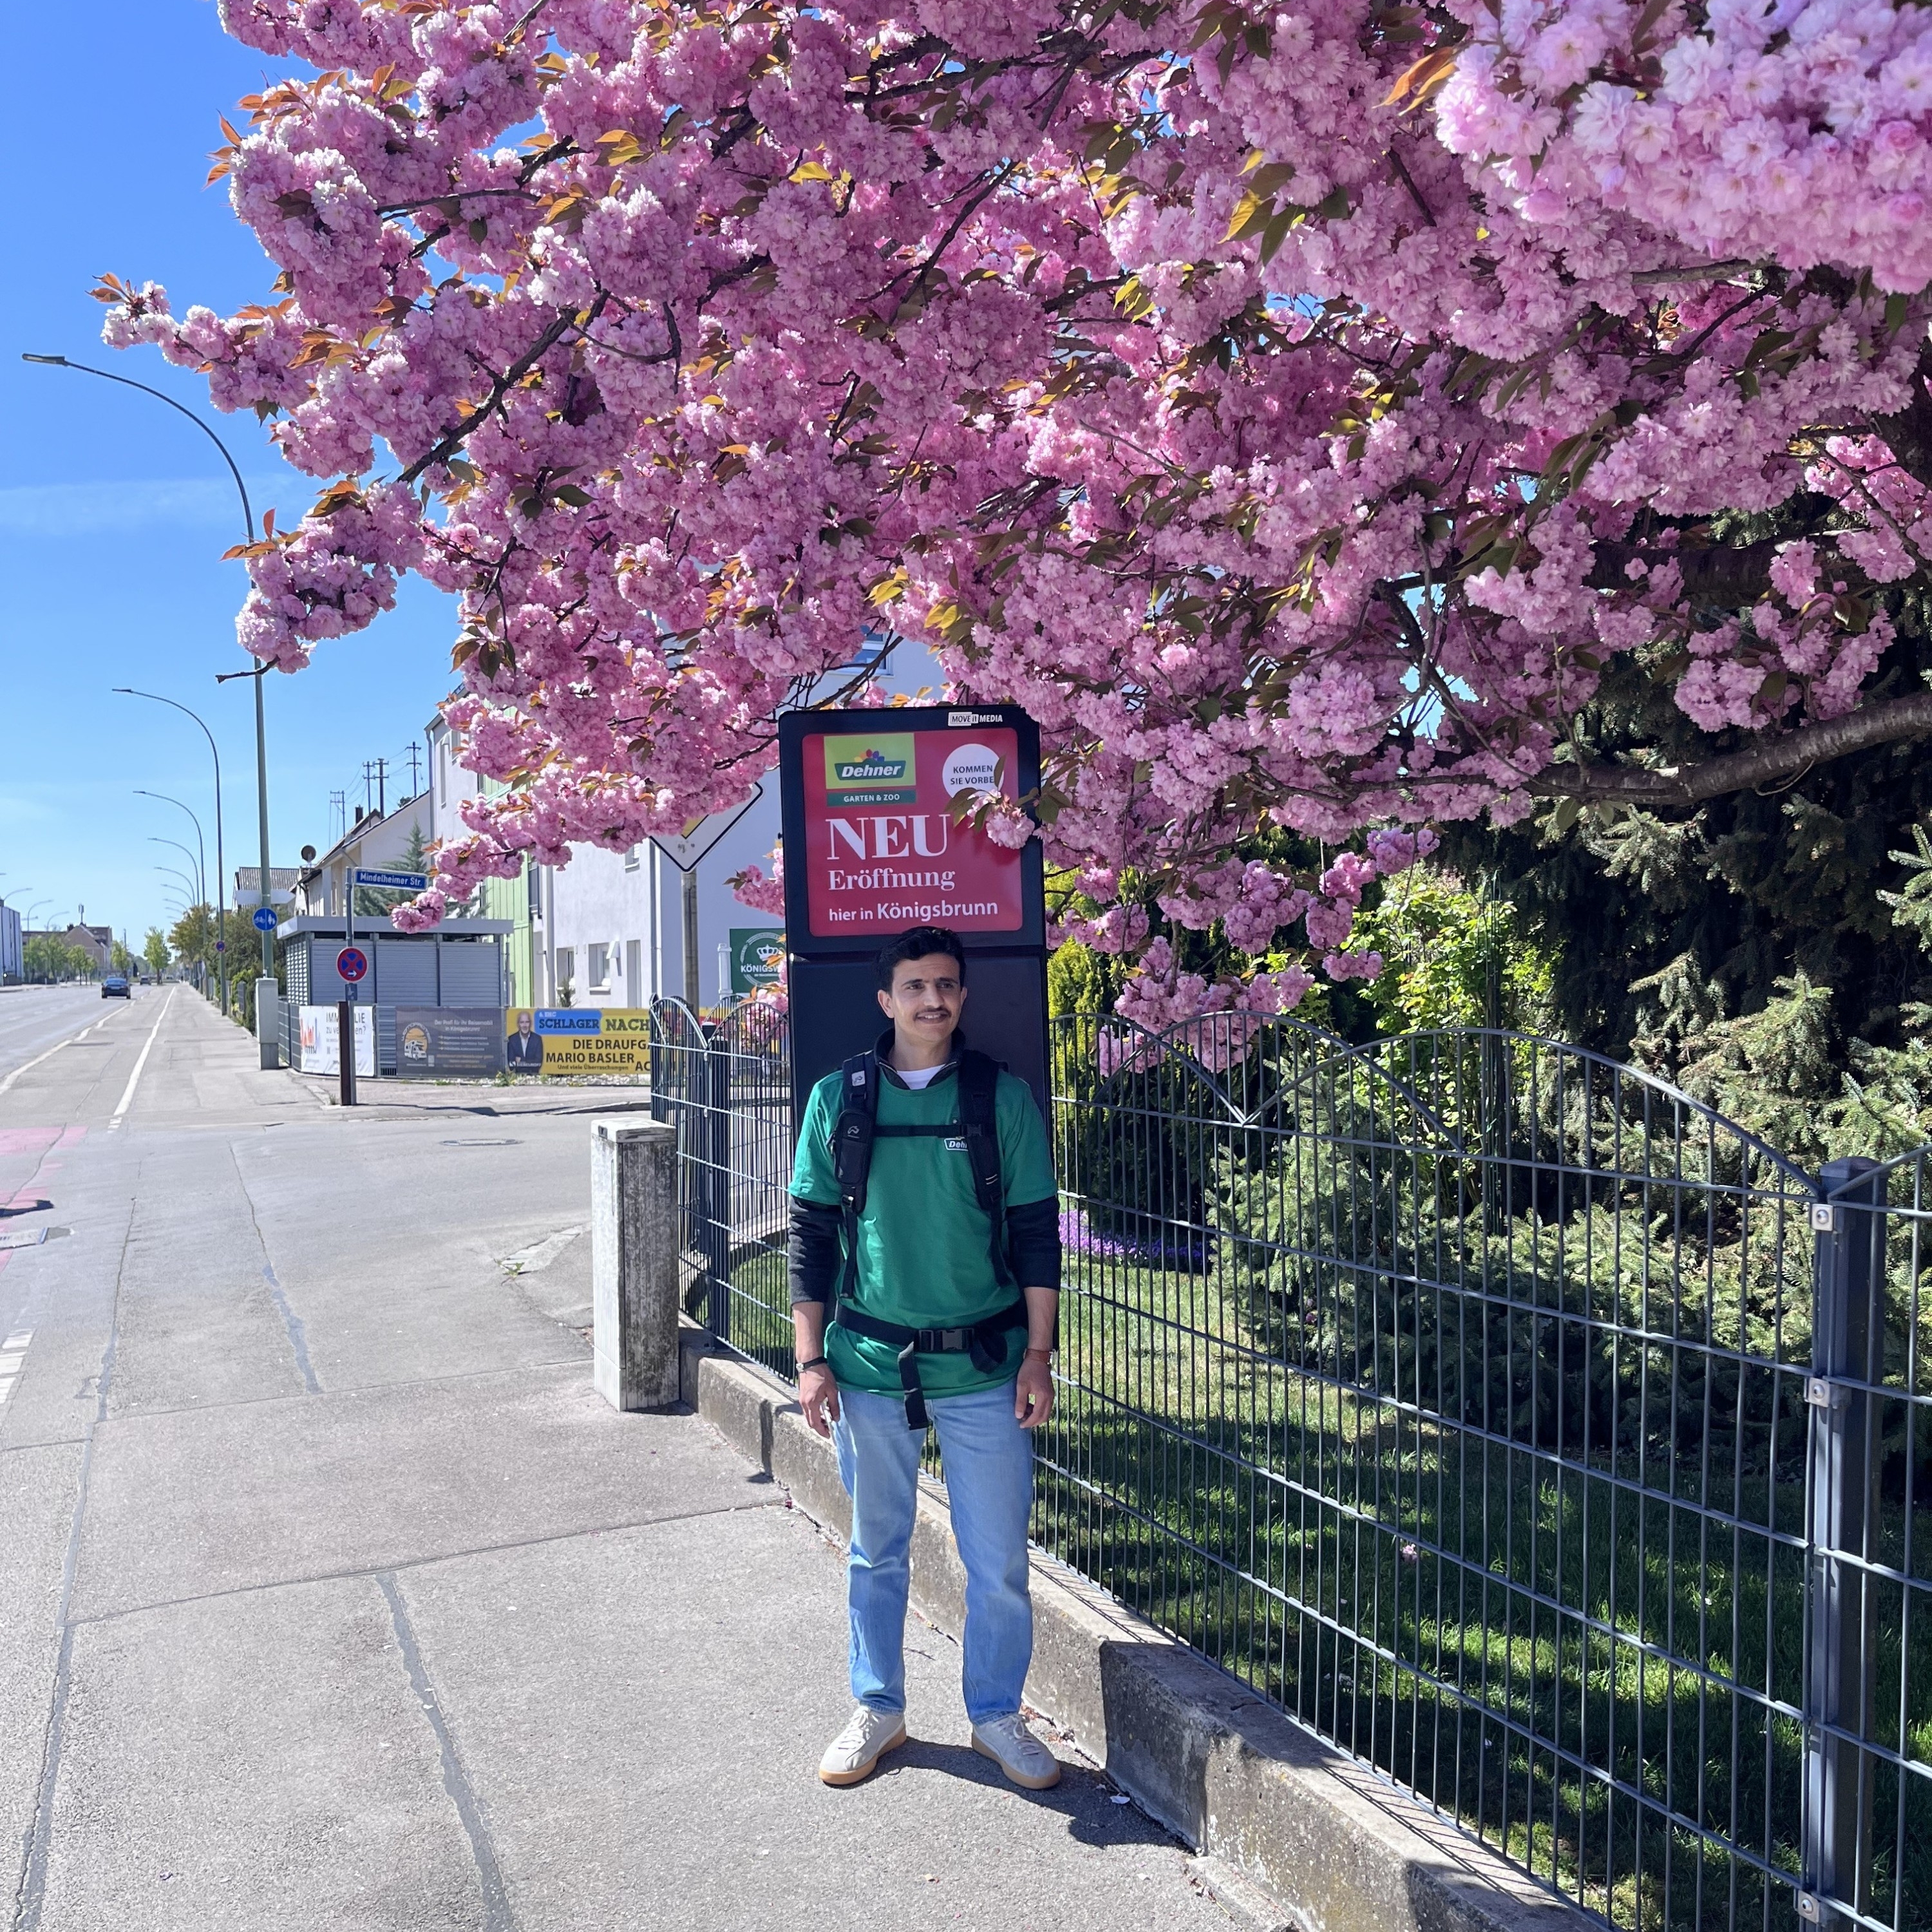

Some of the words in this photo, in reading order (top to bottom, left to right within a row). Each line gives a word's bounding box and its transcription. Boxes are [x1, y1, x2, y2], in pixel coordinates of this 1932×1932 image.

[979, 714, 1003, 723] MEDIA
[841, 764, 902, 777] Dehner
[953, 765, 993, 773] KOMMEN
[965, 776, 995, 784] VORBE
[844, 794, 875, 802] GARTEN
[825, 814, 951, 860] NEU
[360, 872, 409, 885] Mindelheimer
[410, 876, 422, 886] Str.
[828, 867, 956, 891] Eröffnung
[829, 908, 857, 921] hier
[860, 907, 873, 920] in
[877, 900, 998, 922] Königsbrunn
[538, 1018, 600, 1029] SCHLAGER
[605, 1018, 650, 1031] NACH
[573, 1039, 593, 1050] DIE
[595, 1039, 650, 1050] DRAUFG
[546, 1052, 586, 1063] MARIO
[589, 1052, 635, 1063] BASLER
